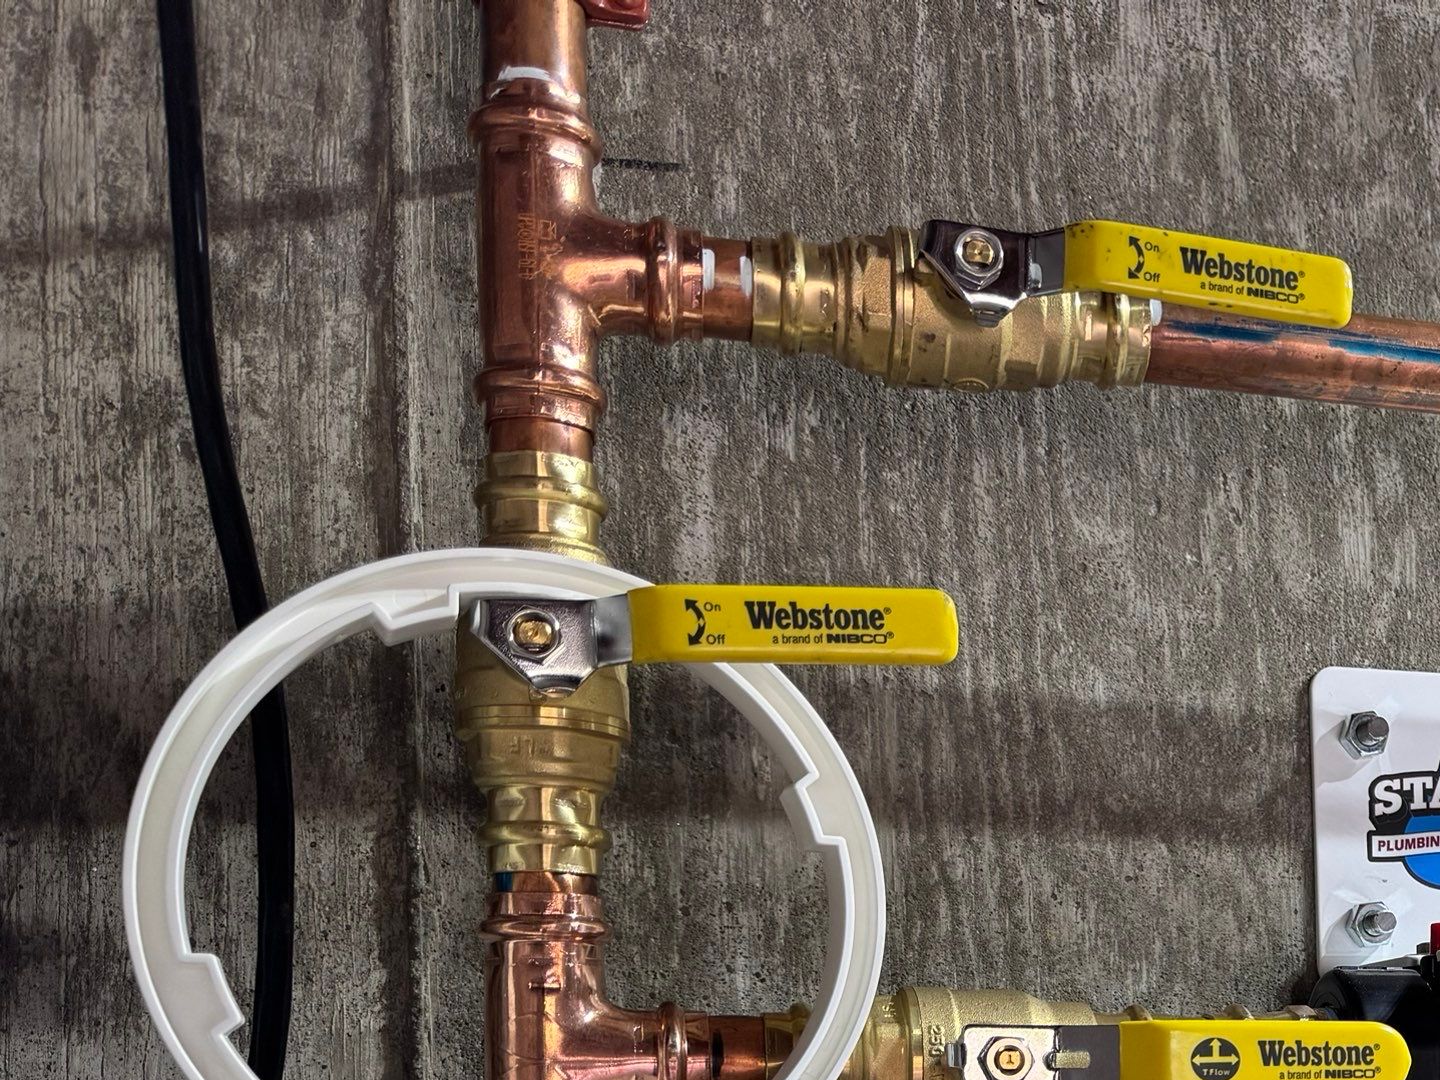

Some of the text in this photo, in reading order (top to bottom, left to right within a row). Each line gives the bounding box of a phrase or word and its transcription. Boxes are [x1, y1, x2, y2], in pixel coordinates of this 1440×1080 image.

[1144, 241, 1160, 252] On
[1143, 271, 1160, 283] Off
[1200, 282, 1206, 290] a
[1208, 281, 1233, 295] brand
[1236, 286, 1245, 296] of
[704, 601, 721, 612] On
[706, 633, 726, 645] Off
[772, 635, 779, 644] a
[781, 632, 812, 645] brand
[814, 632, 824, 645] of
[1279, 1071, 1285, 1080] a
[1287, 1068, 1312, 1080] brand
[1314, 1068, 1323, 1080] of
